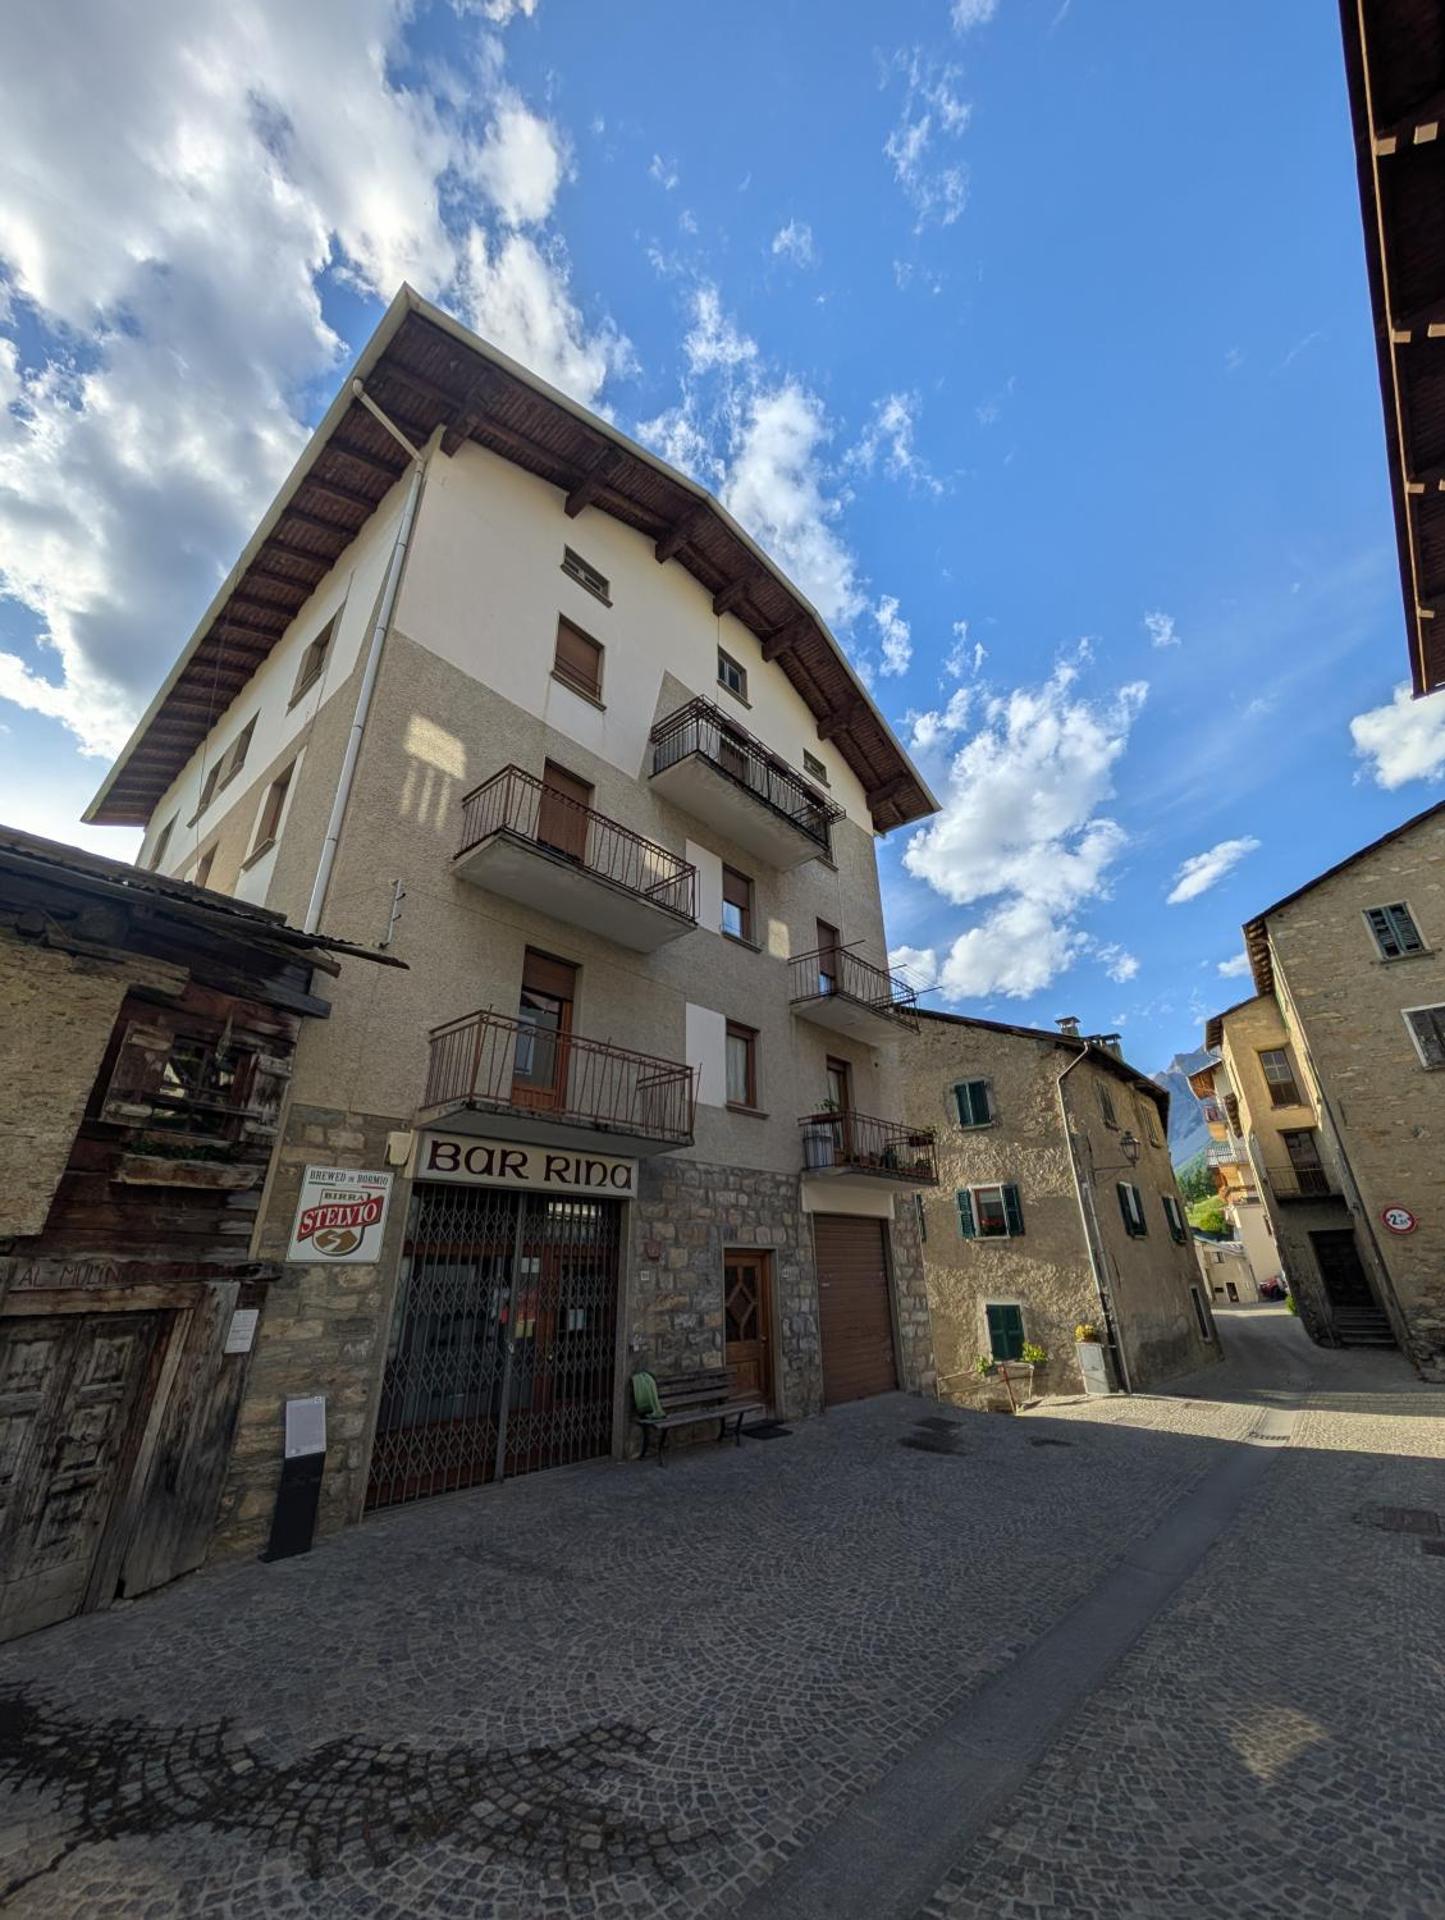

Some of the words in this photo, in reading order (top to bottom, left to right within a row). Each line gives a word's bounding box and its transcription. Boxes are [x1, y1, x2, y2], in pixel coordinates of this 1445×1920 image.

[427, 1140, 529, 1179] BAR
[310, 1170, 346, 1183] BREWED
[356, 1174, 388, 1186] BORMIO
[324, 1192, 367, 1203] BIRRA
[301, 1202, 377, 1233] STELVIO
